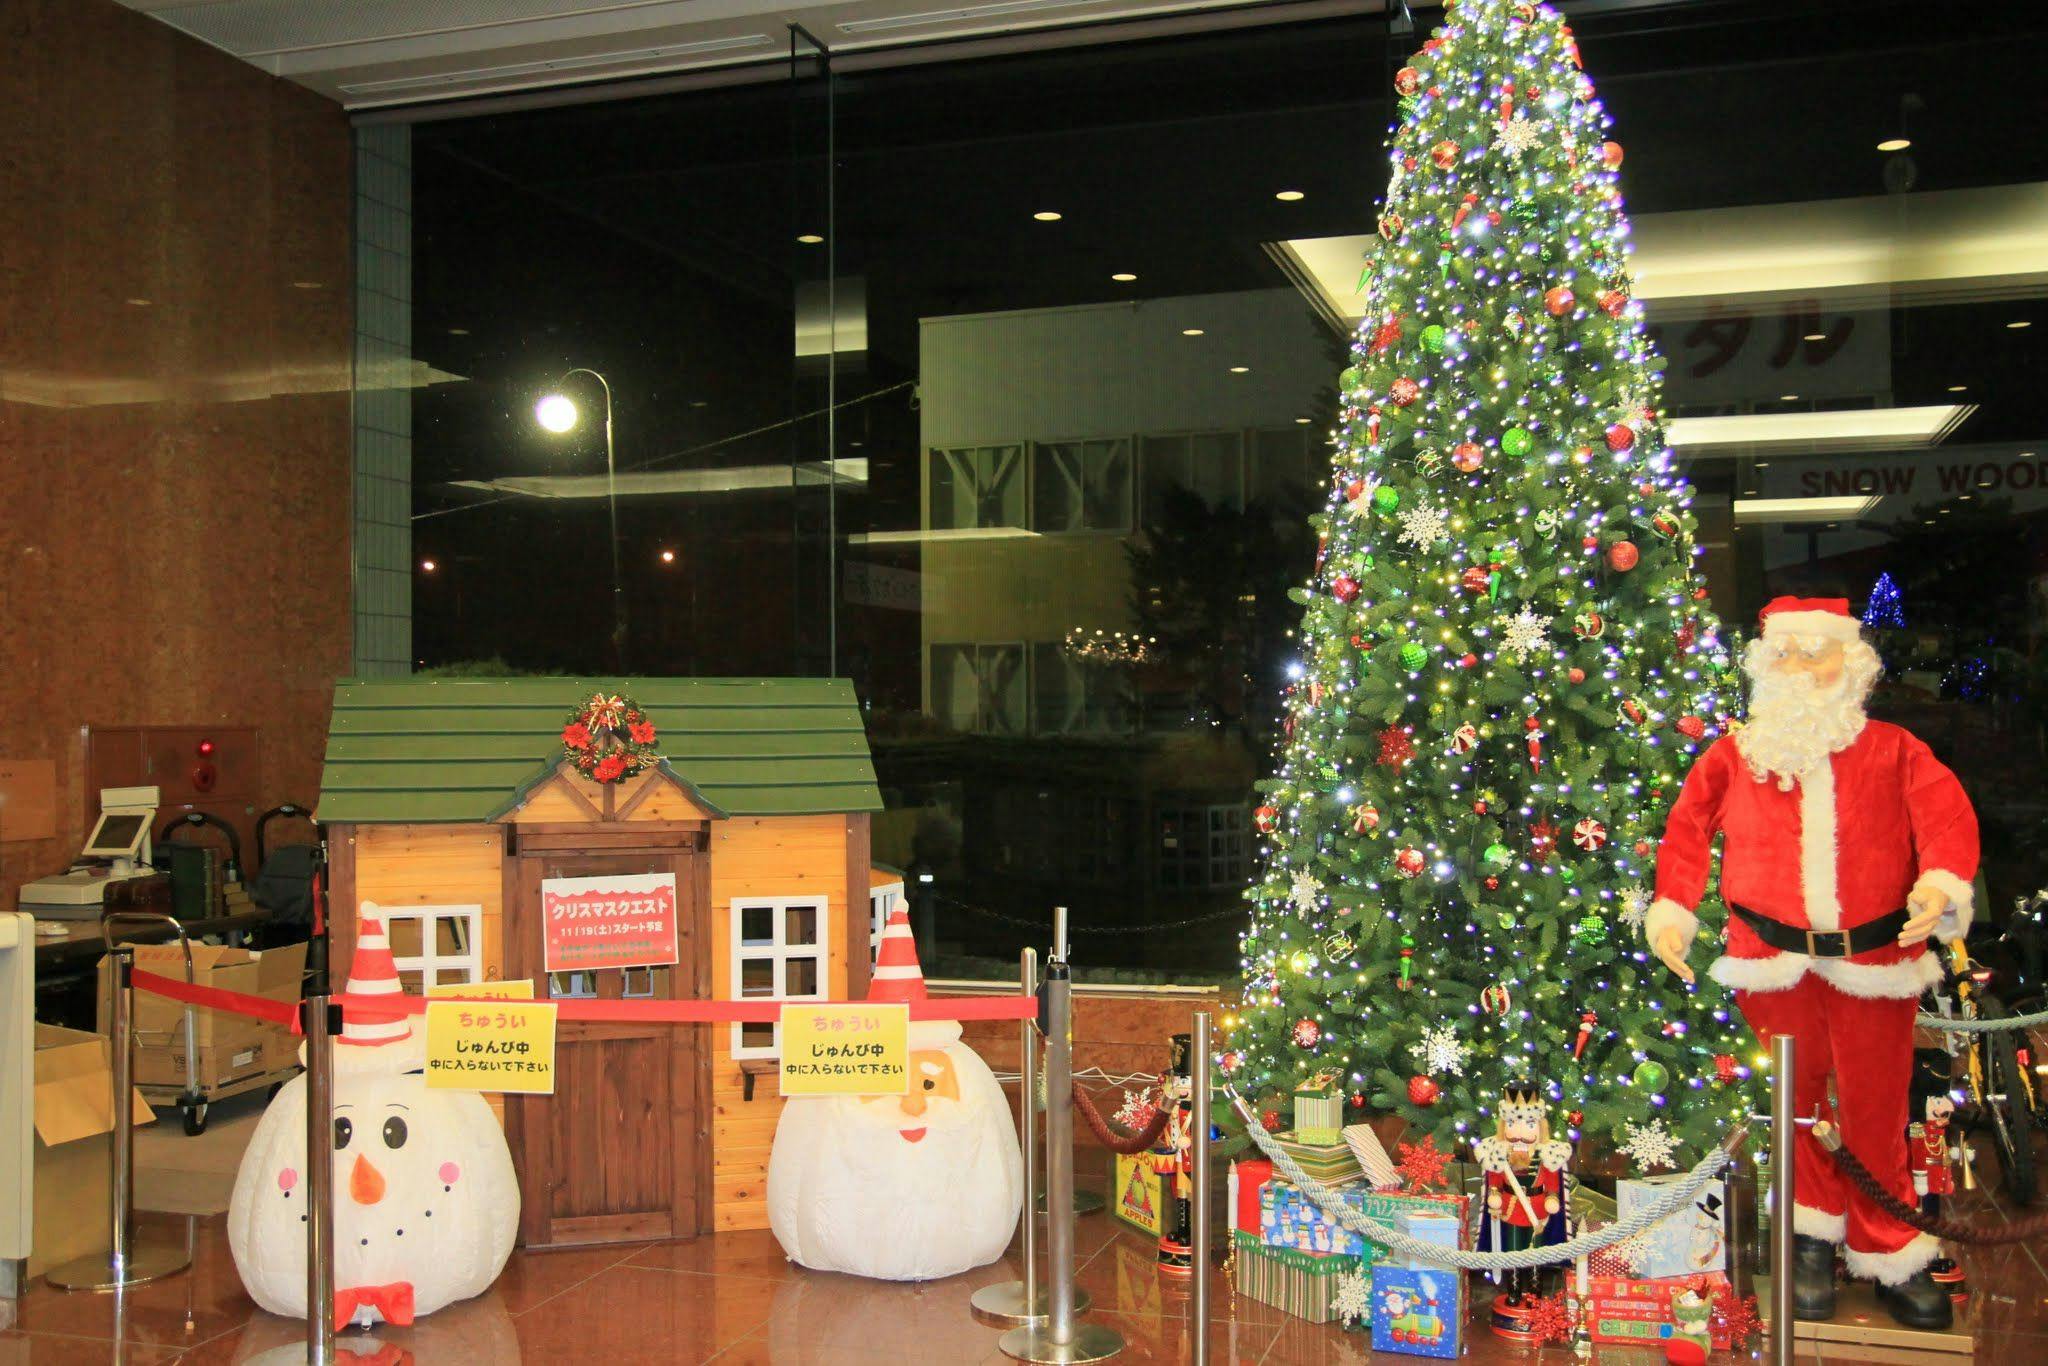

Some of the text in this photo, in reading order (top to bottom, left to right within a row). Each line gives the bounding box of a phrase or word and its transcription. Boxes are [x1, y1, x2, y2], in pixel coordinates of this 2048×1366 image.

[1650, 298, 1855, 378] タル
[1801, 466, 1916, 497] SNOW
[552, 898, 668, 920] クリスマスクエスト
[458, 1011, 526, 1029] ちゅうい
[812, 1015, 880, 1032] ちゅうい
[456, 1039, 530, 1055] じゅんび中
[812, 1043, 884, 1058] じゅんび中
[430, 1059, 549, 1073] 中に入らないで下さい
[786, 1063, 903, 1075] 中に入らないで下さい
[1124, 1208, 1153, 1228] APPLES
